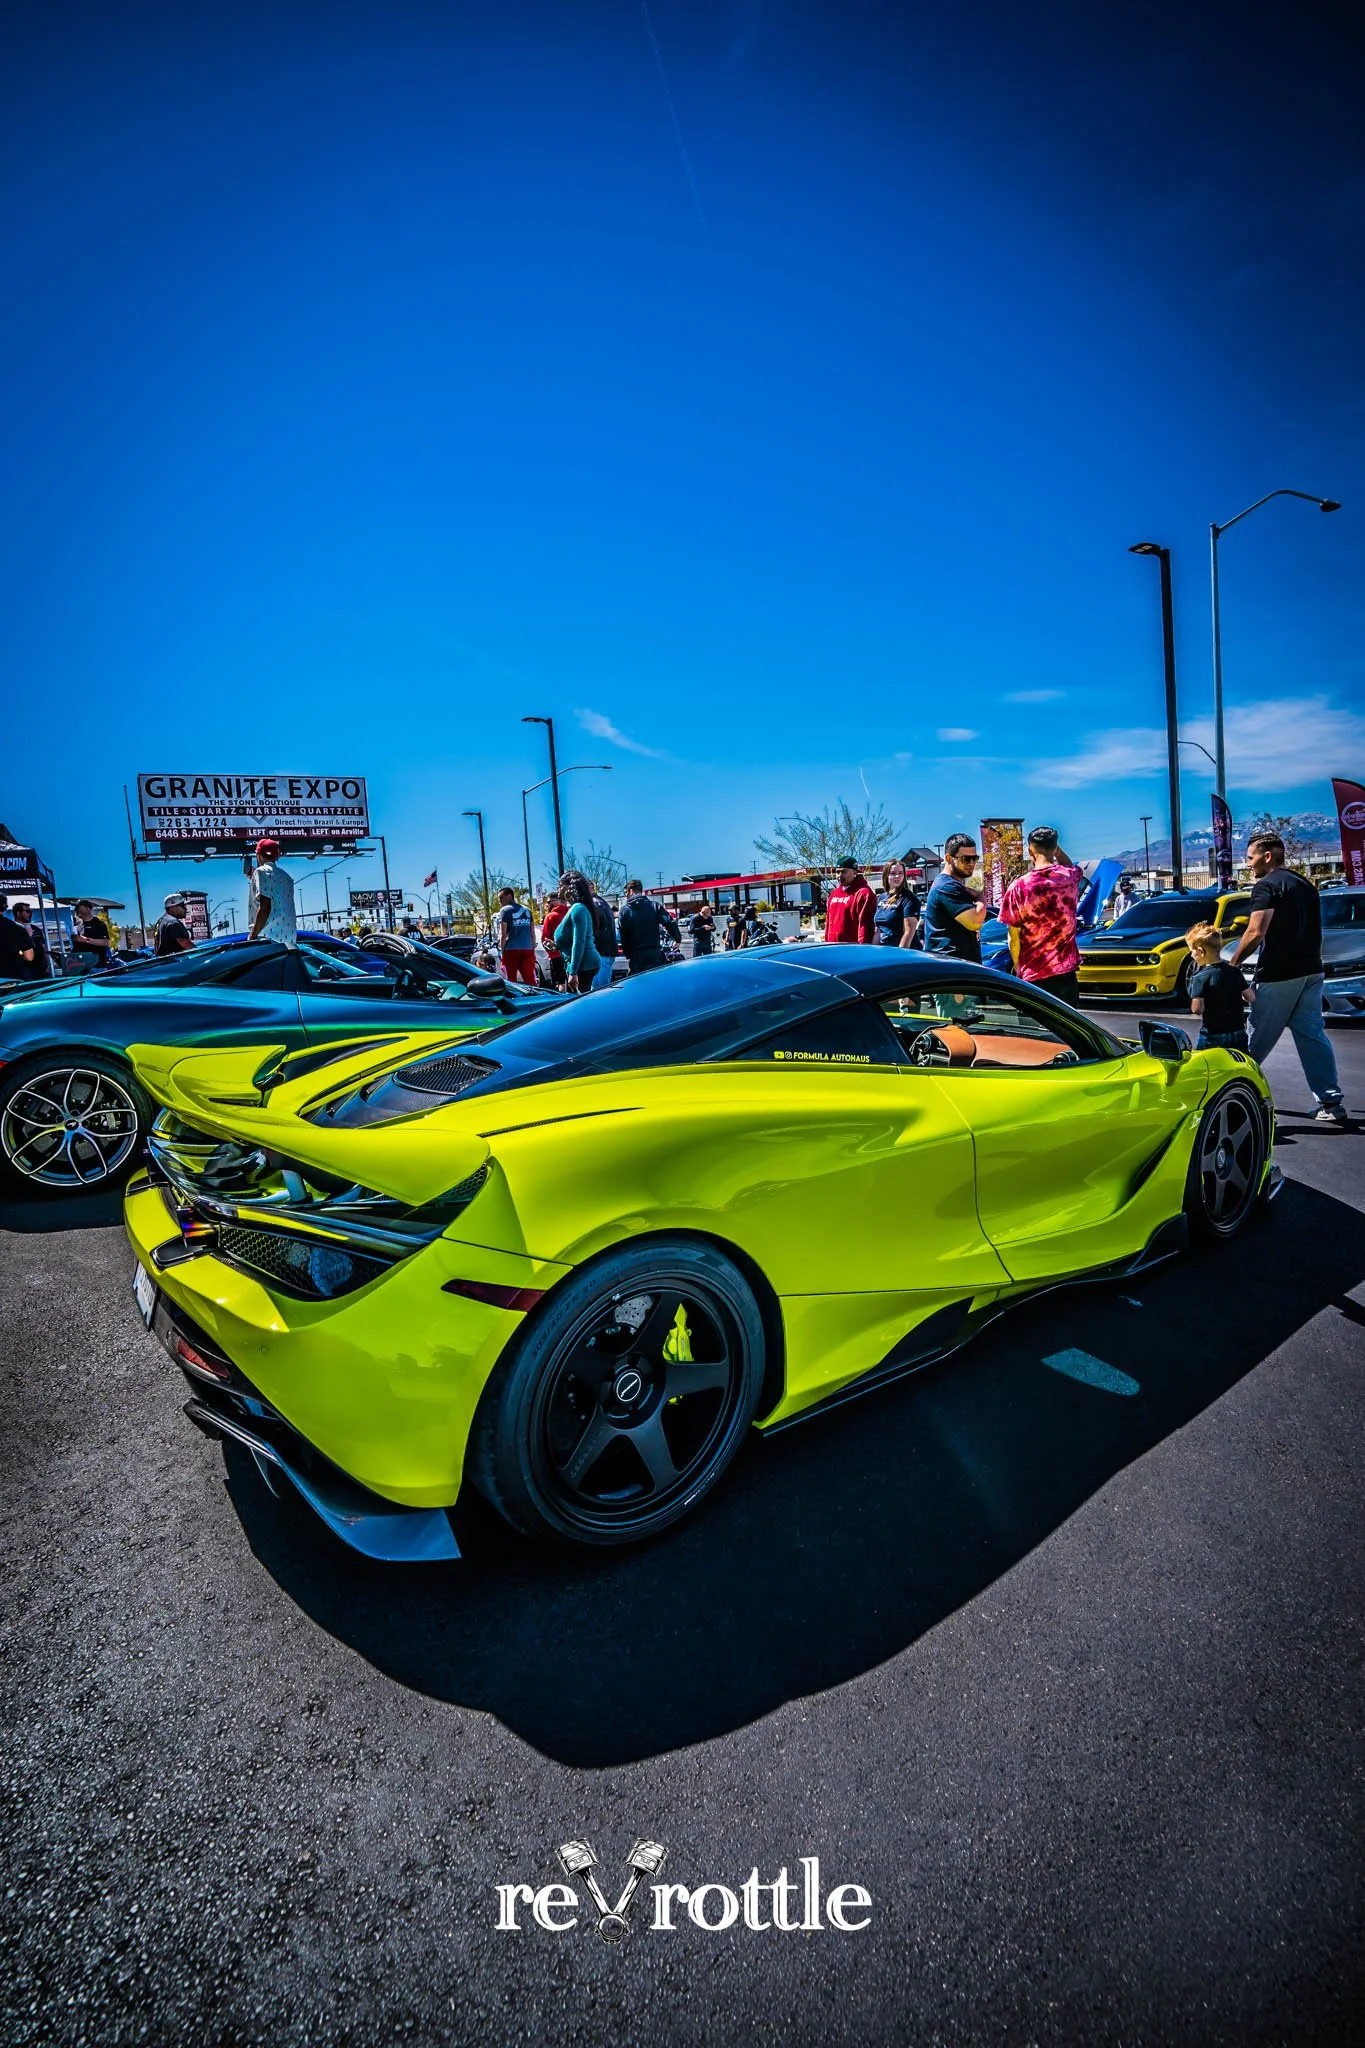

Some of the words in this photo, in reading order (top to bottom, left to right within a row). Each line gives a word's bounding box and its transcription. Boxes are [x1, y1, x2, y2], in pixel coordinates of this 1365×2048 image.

[145, 777, 278, 798] GRANITE
[288, 779, 360, 799] EXPO
[153, 807, 180, 815] TILE
[189, 807, 237, 815] QUARTZ
[246, 807, 291, 815] MARBLE
[300, 807, 360, 815] QUARTZITE
[166, 818, 227, 828] 263-1224
[342, 819, 365, 827] Europe
[155, 829, 179, 838] 6446
[181, 829, 191, 838] S.
[192, 829, 222, 838] Arville
[224, 829, 237, 837] St.
[280, 828, 307, 836] Sunset,
[793, 1051, 829, 1061] FORMULA
[831, 1053, 870, 1063] AUTOHAUS
